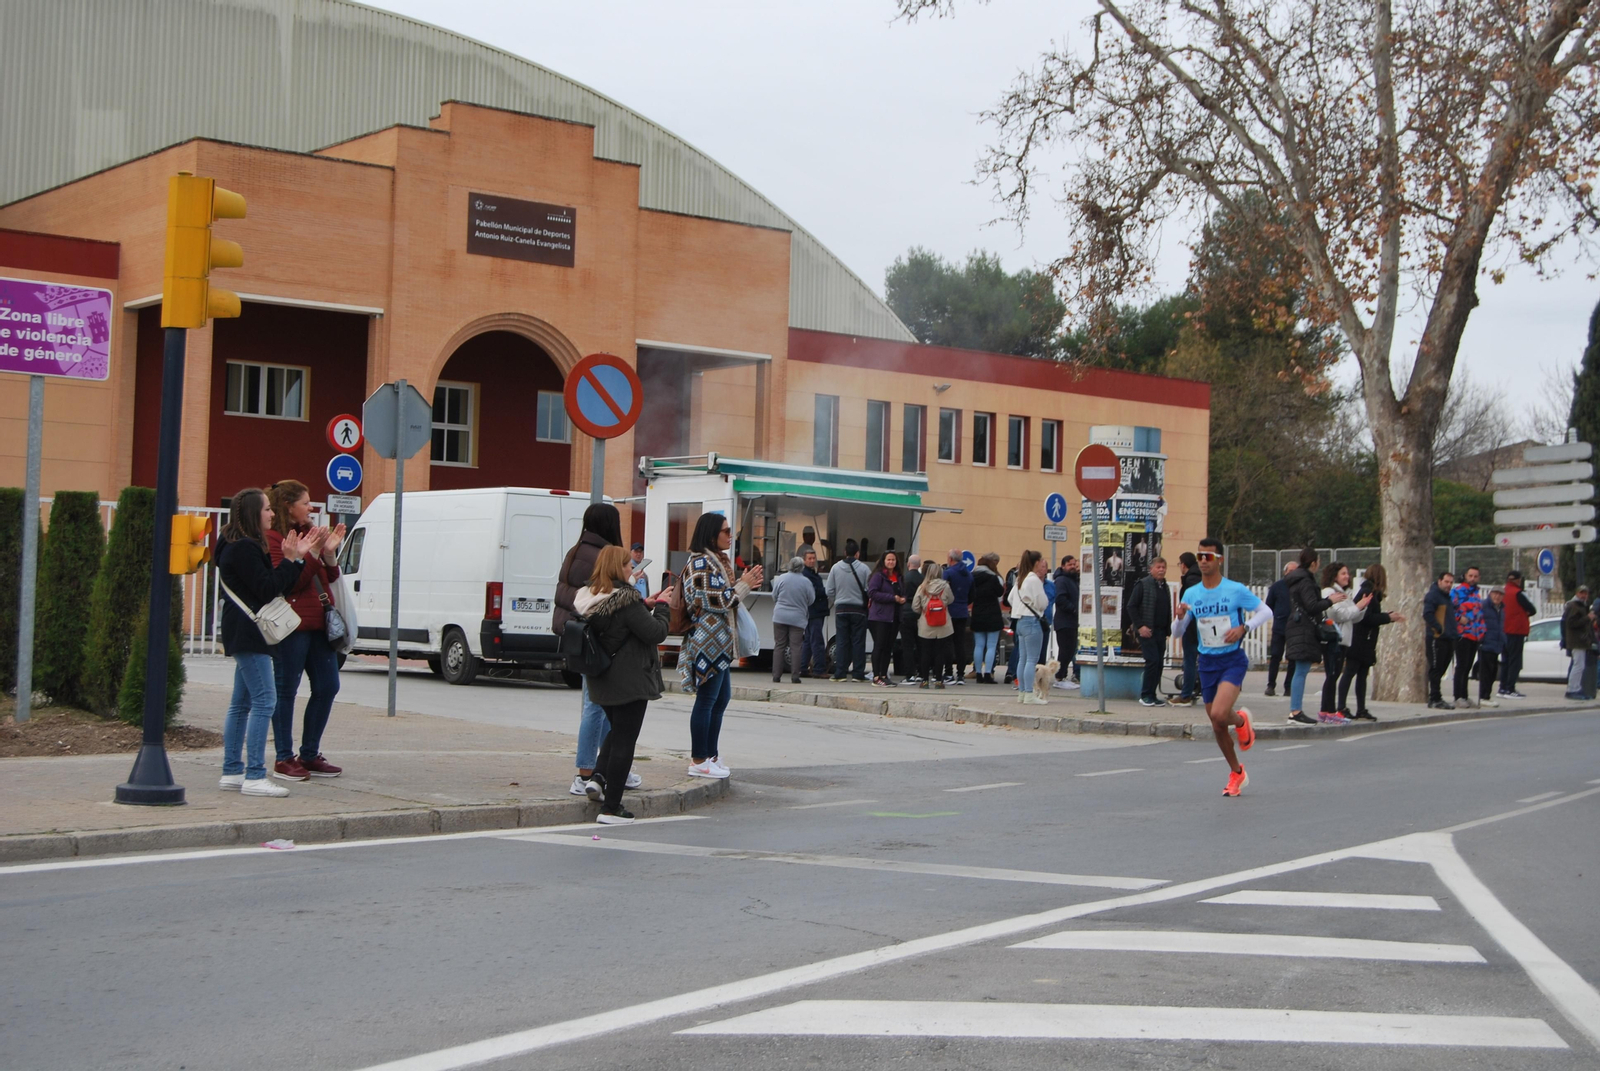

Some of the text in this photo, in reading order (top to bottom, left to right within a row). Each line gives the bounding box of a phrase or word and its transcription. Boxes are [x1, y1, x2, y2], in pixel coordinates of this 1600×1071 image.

[475, 219, 502, 230] Pabellón
[503, 223, 533, 235] Municipal
[543, 229, 571, 240] Deportes
[475, 231, 570, 250] Antonio Ruiz-Canela Evangelista
[0, 307, 85, 328] Zona libre
[0, 327, 92, 346] e violencia
[0, 343, 83, 363] de género
[516, 602, 533, 610] 3052
[1195, 602, 1228, 615] nerja
[1211, 625, 1217, 636] 1
